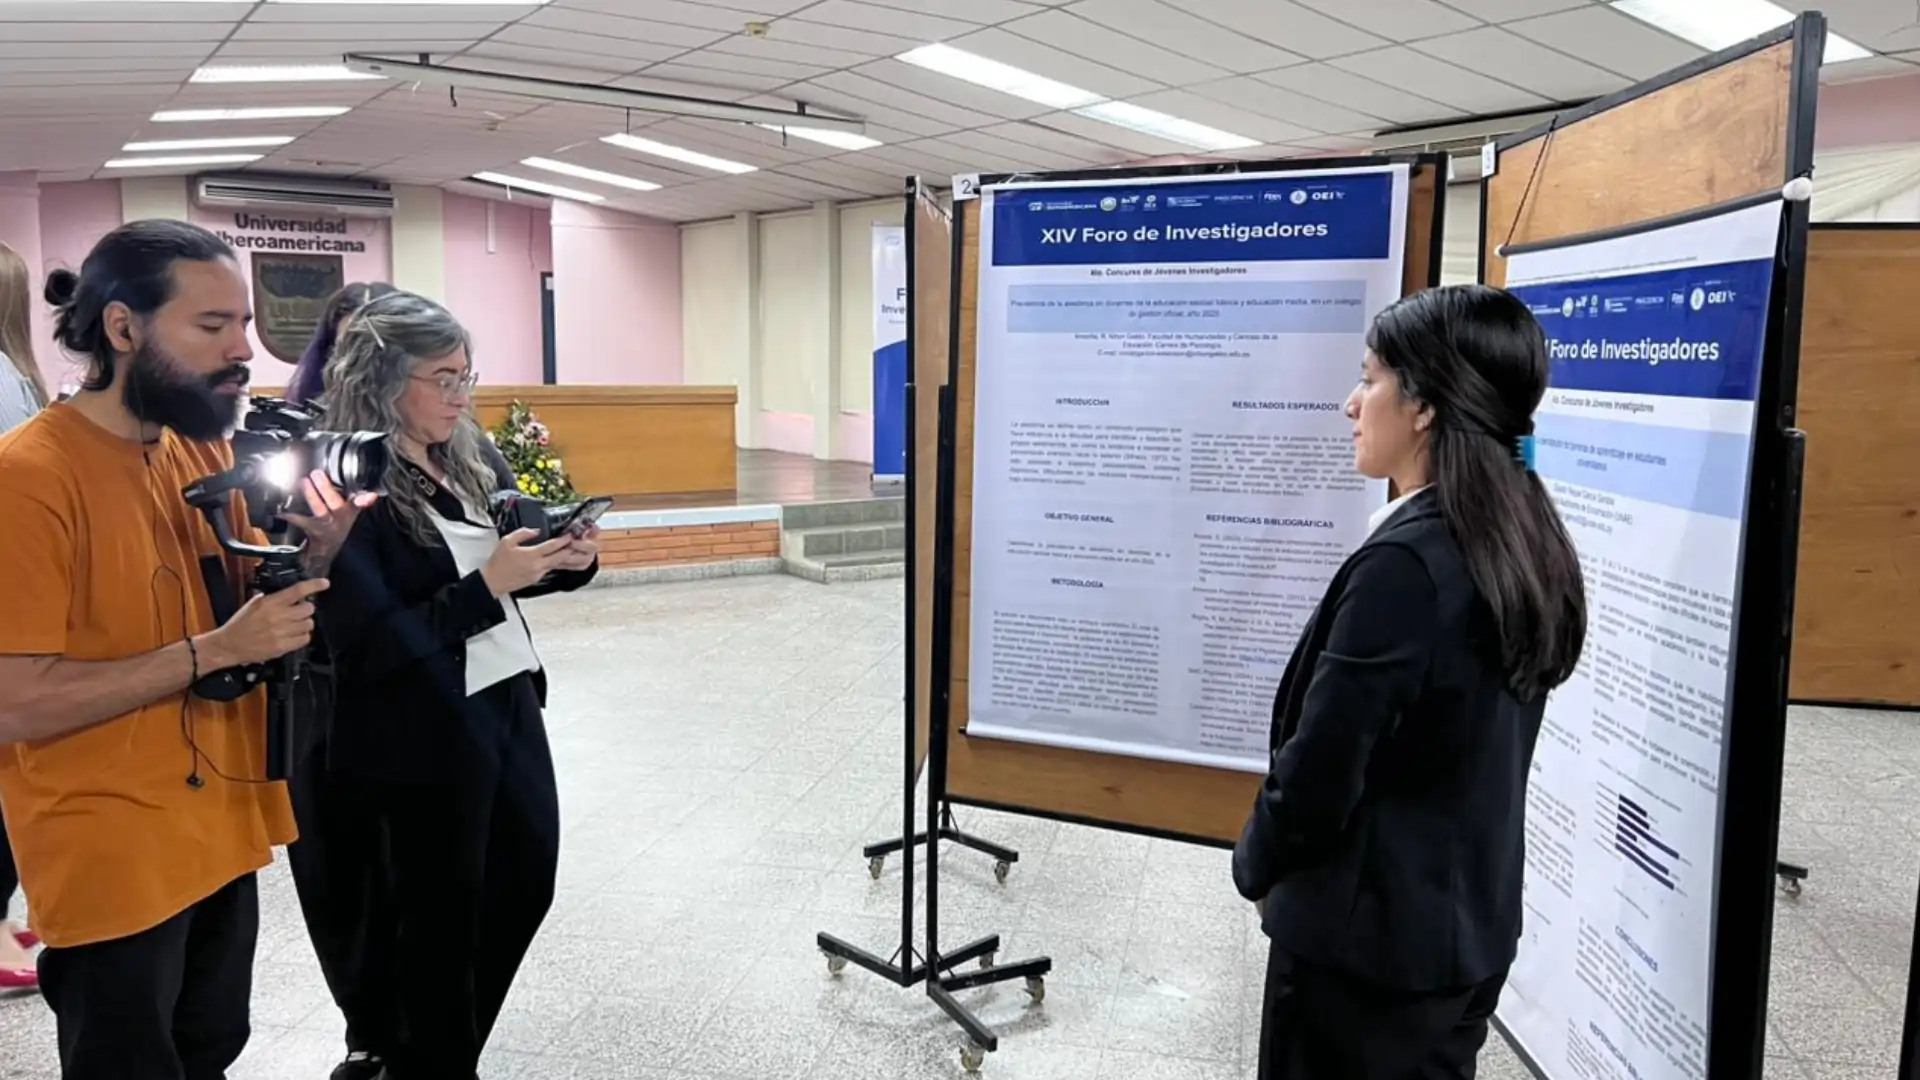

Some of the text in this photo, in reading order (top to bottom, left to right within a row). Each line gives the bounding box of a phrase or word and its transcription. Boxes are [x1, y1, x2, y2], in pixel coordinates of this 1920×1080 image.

[961, 178, 972, 195] 2
[234, 212, 348, 234] Universidad
[216, 230, 366, 252] beroamericana
[1040, 221, 1329, 245] XIV Foro de Investigadores
[1188, 265, 1248, 277] Investigadores
[1549, 337, 1720, 366] Foro de Investigadores
[1231, 400, 1340, 412] RESULTADOS ESPERADOS
[1044, 511, 1115, 524] OBJETIVO GENERAL
[1205, 513, 1263, 526] REFERENCIAS
